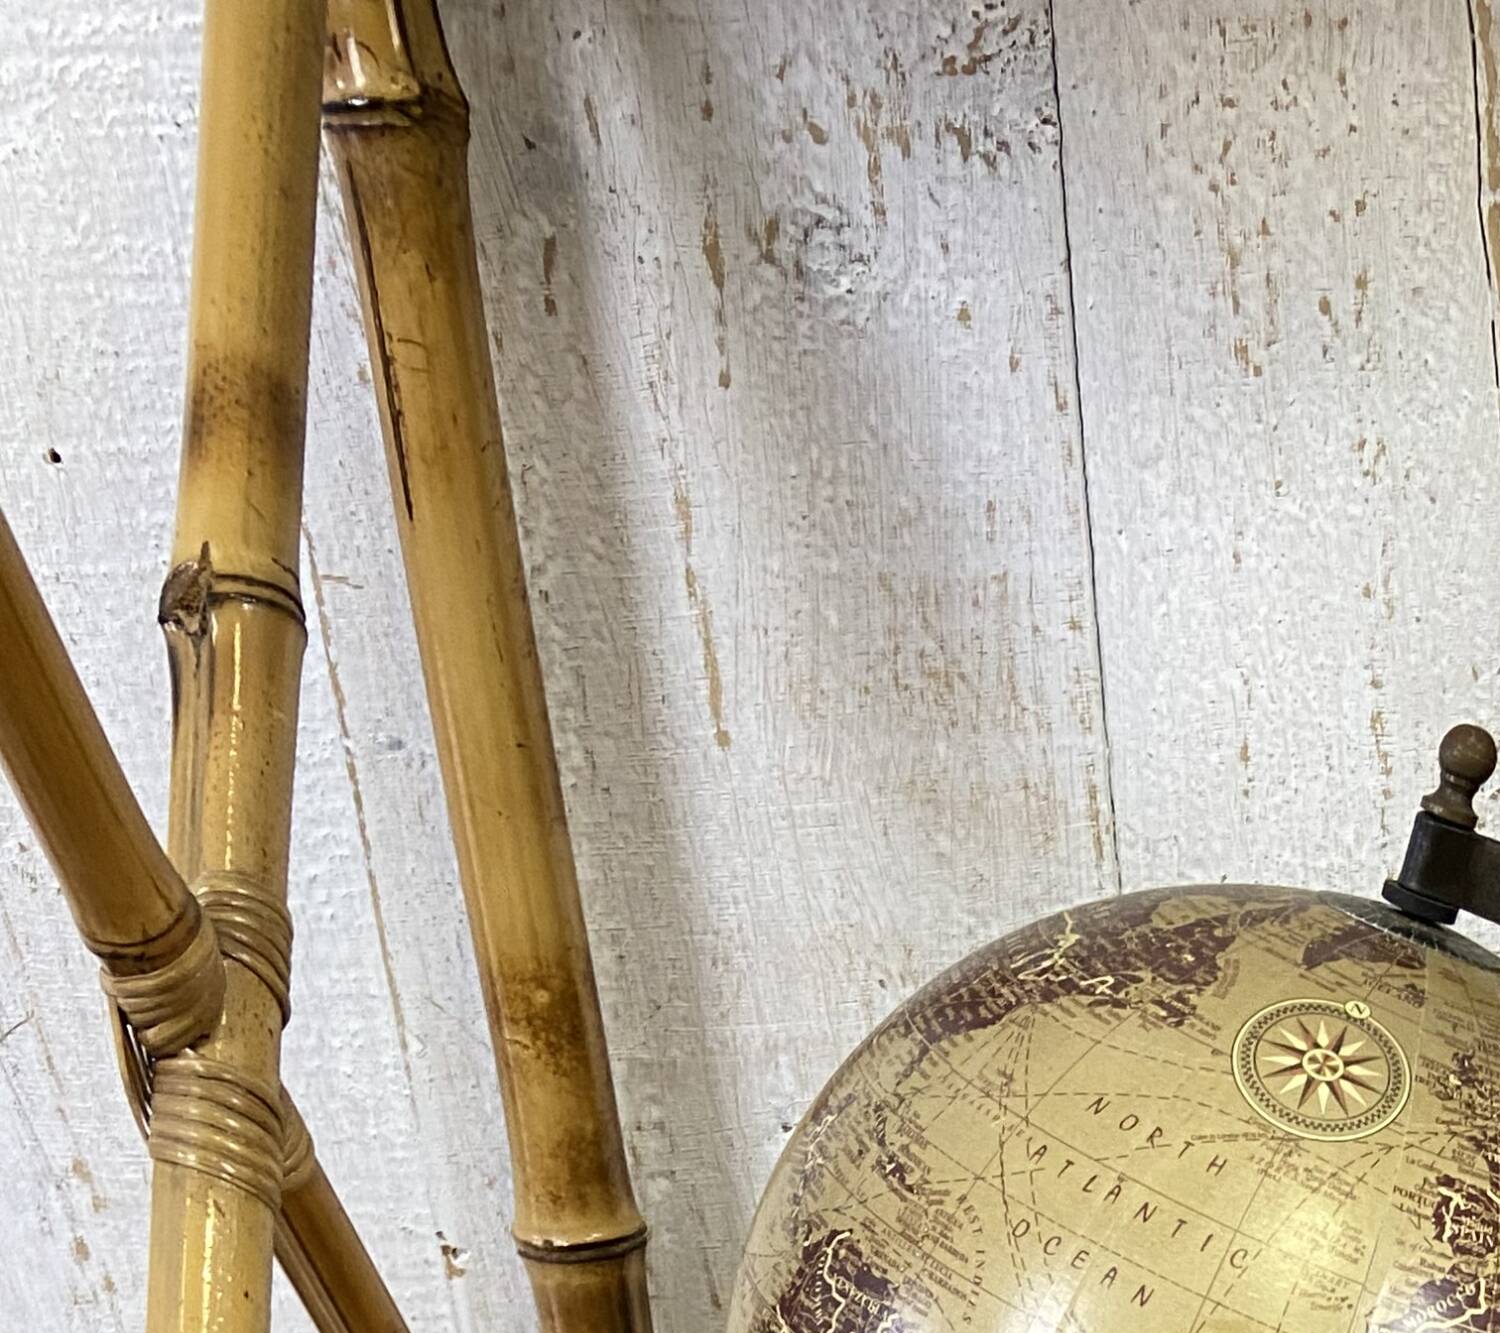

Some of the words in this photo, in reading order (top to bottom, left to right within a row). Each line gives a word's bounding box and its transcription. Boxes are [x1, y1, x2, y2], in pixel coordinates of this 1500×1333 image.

[1085, 1096, 1228, 1177] NORTH
[1029, 1144, 1249, 1270] ATLANTIC
[1011, 1218, 1155, 1307] OCEAN
[1402, 1284, 1477, 1328] MOROCCO
